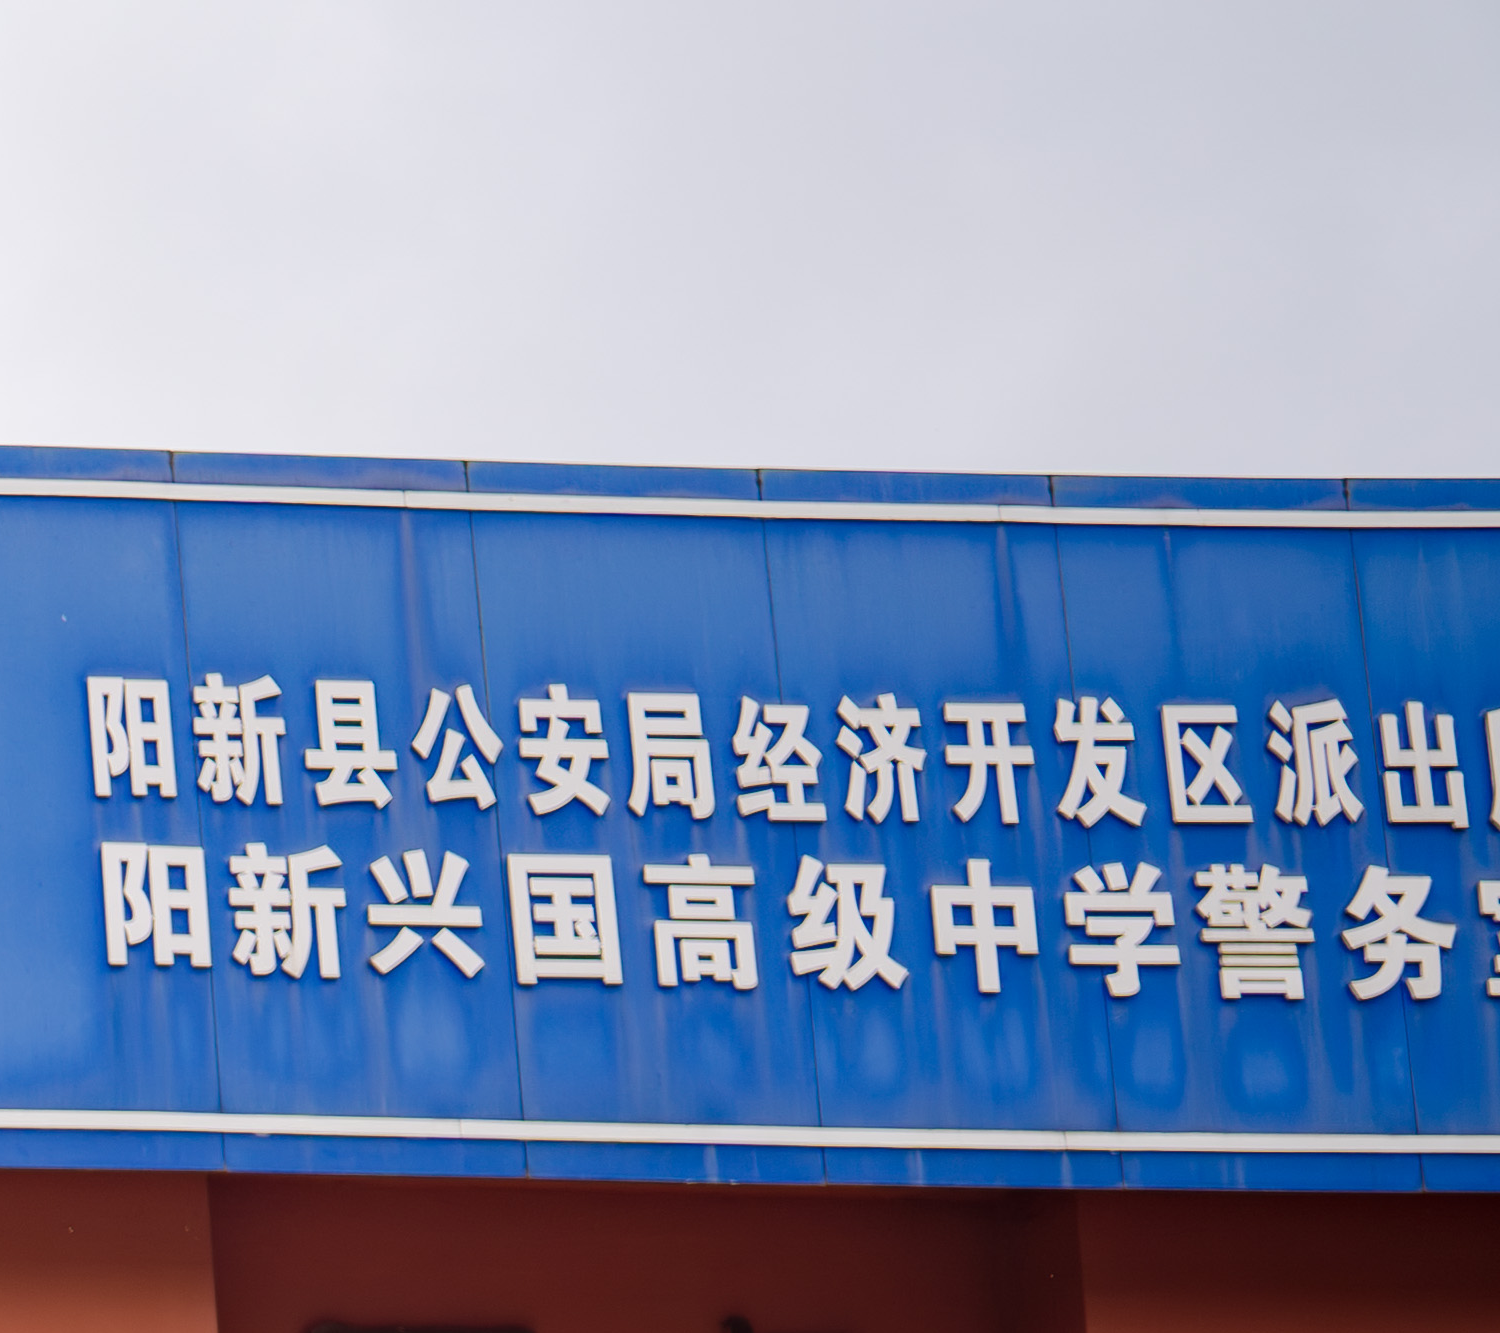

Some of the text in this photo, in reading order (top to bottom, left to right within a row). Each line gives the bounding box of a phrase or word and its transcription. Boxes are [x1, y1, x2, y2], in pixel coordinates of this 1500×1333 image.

[87, 672, 1500, 830] 阳新县公安局经济开发区派出
[100, 840, 1500, 1001] 阳新兴国高级中学警务
